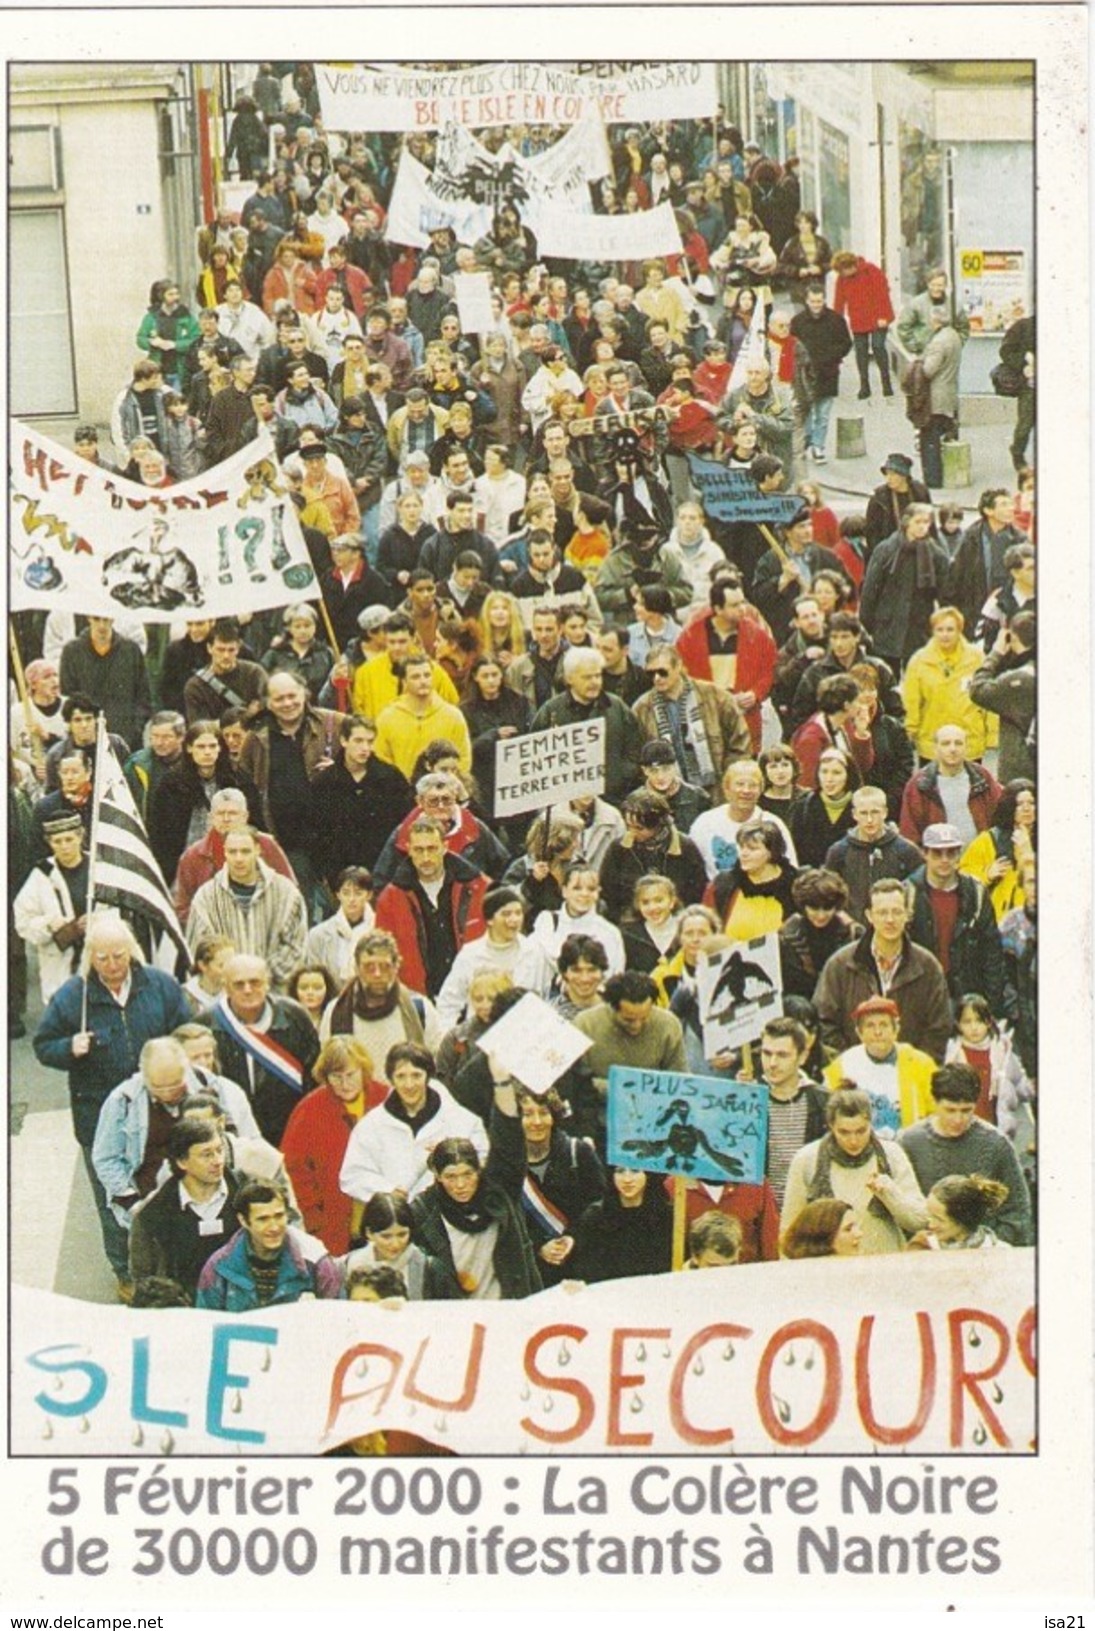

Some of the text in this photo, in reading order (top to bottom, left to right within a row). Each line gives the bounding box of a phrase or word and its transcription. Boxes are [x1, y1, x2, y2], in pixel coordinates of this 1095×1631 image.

[324, 71, 367, 94] VOUS
[373, 78, 391, 95] NE
[394, 76, 457, 98] VIENDREZ
[460, 72, 494, 95] PLUS
[499, 63, 539, 92] CHEZ
[478, 95, 516, 122] ISLE
[962, 254, 981, 271] 60
[593, 407, 667, 434] ERIKA
[503, 726, 600, 762] FEMMES
[519, 748, 587, 777] ENTRE
[497, 763, 606, 800] TERRE ET MER
[641, 1073, 698, 1096] PLUS
[25, 1323, 279, 1444] SLE
[317, 1323, 487, 1444] AU
